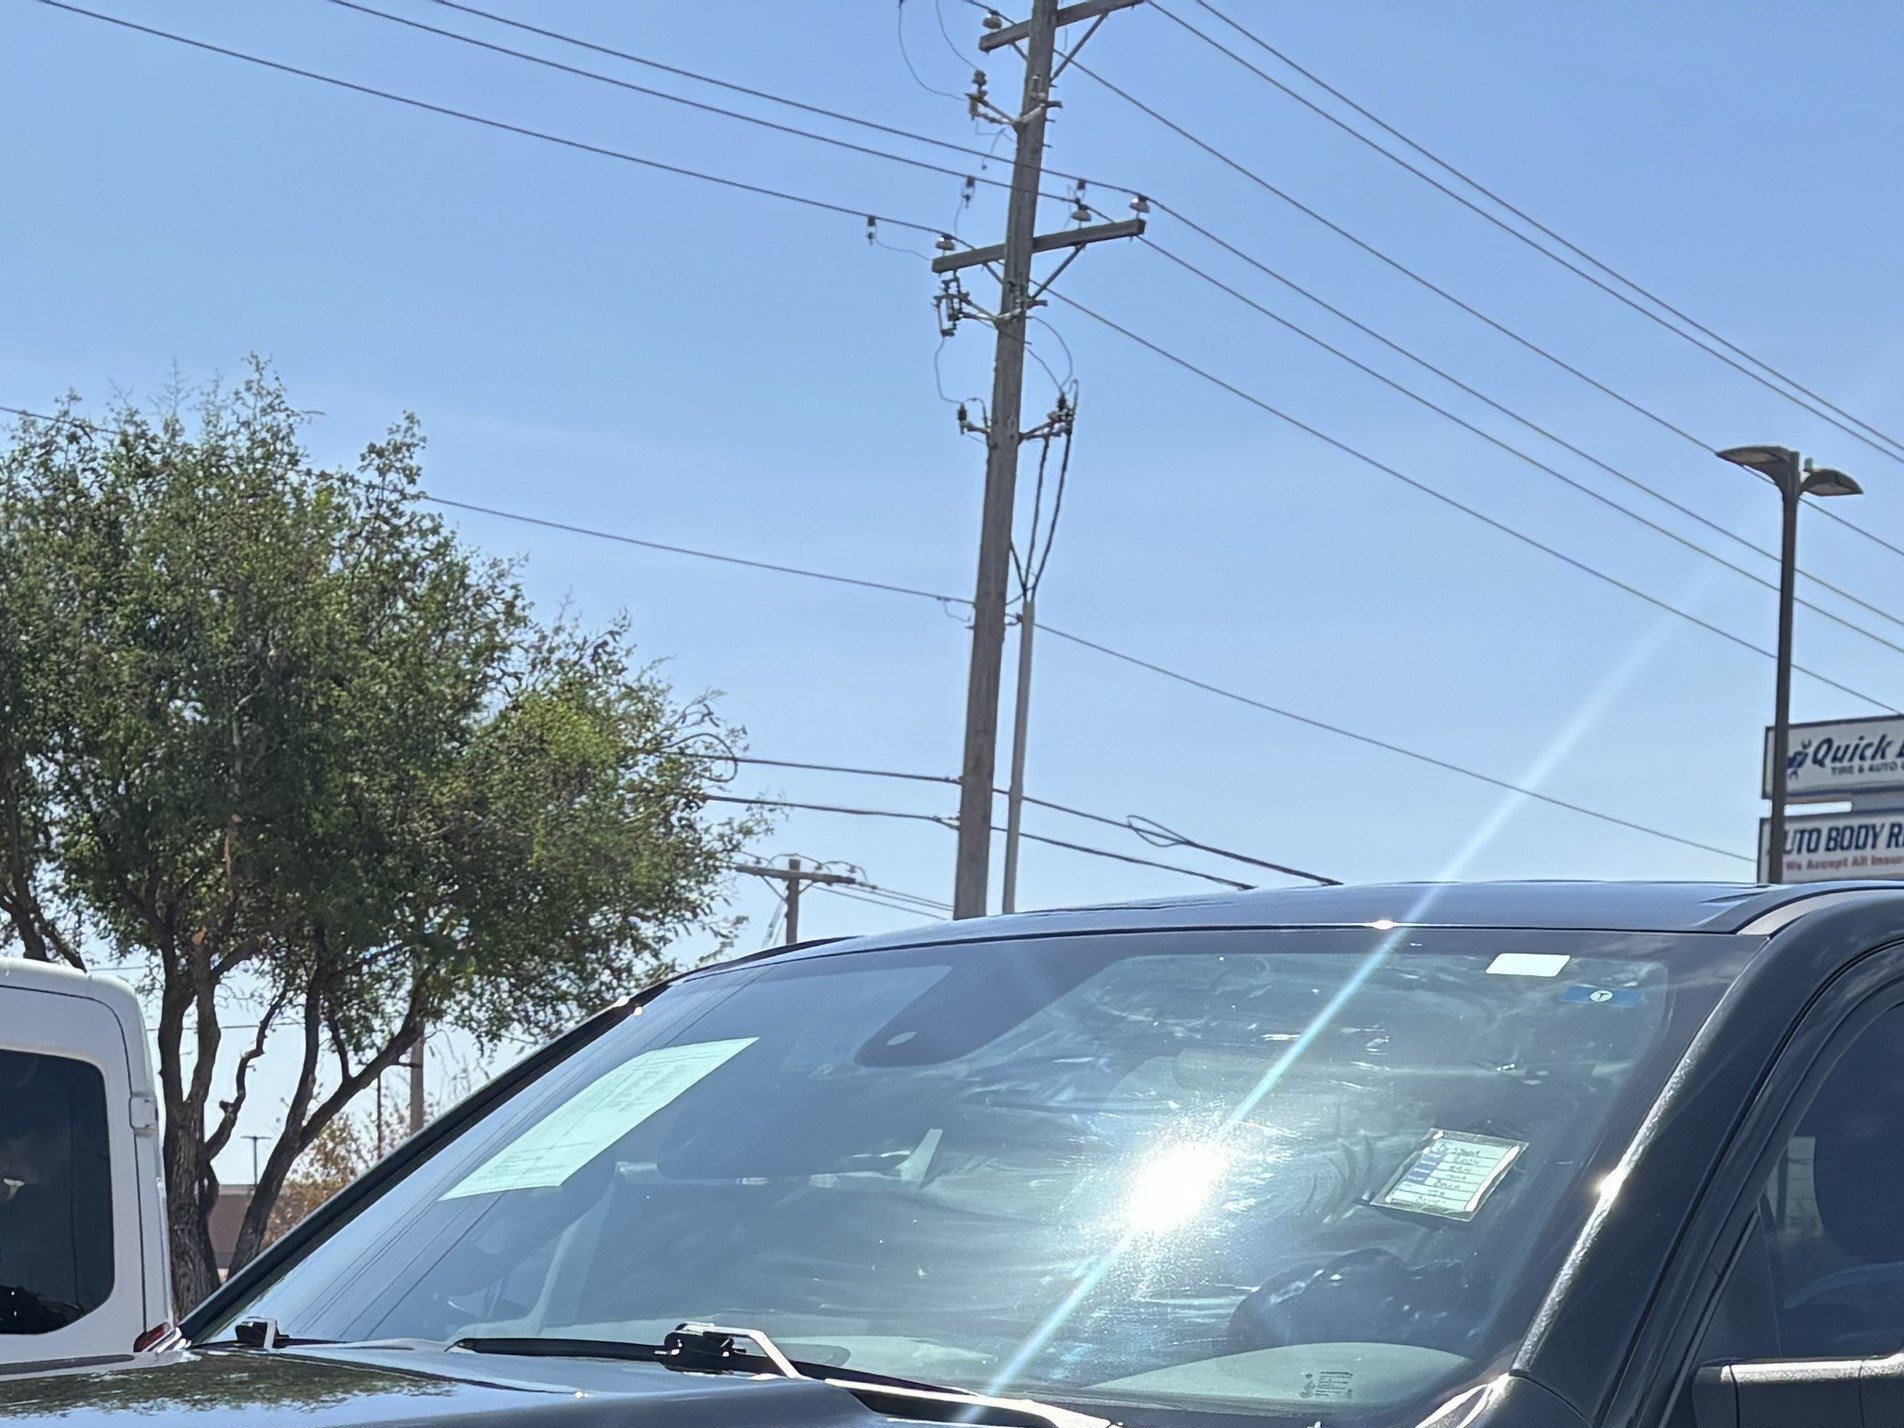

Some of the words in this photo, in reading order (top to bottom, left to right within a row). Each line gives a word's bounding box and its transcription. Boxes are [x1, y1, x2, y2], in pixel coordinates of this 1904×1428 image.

[1811, 733, 1893, 768] Quick
[1868, 761, 1898, 773] AUTO
[1780, 827, 1822, 855] UTO
[1824, 823, 1886, 853] BODY
